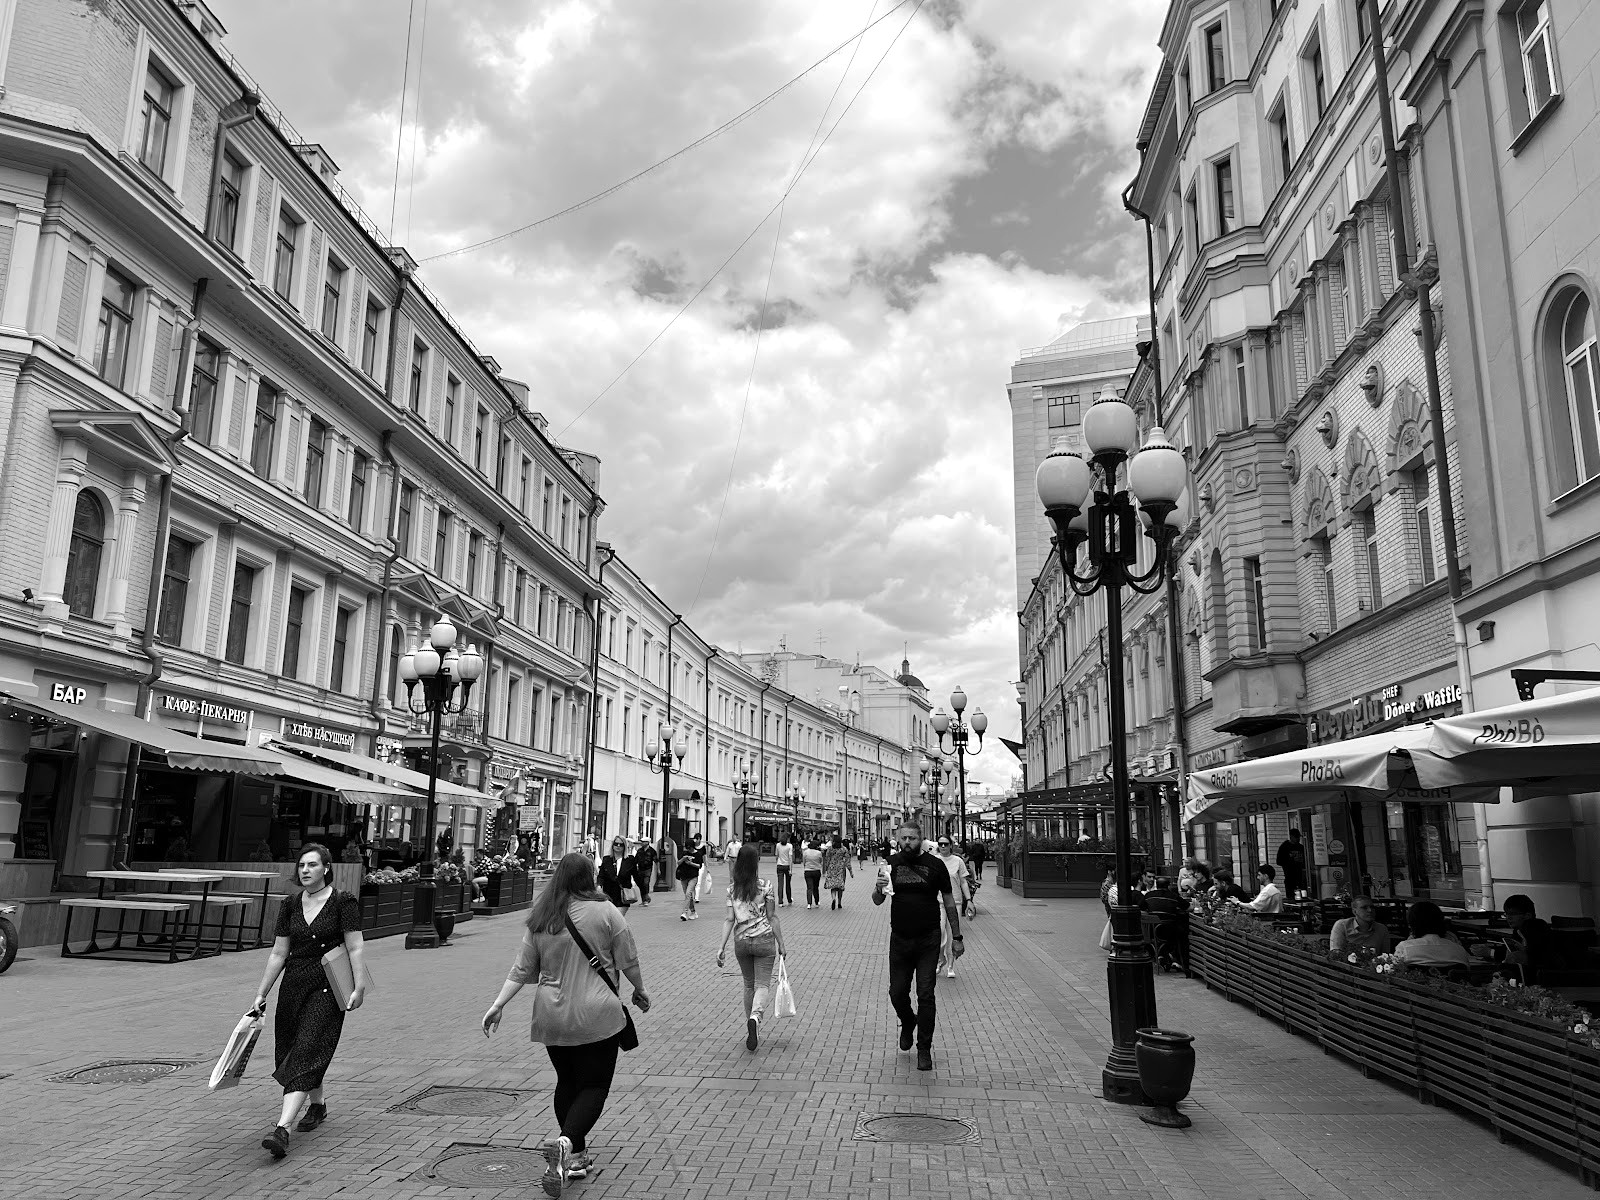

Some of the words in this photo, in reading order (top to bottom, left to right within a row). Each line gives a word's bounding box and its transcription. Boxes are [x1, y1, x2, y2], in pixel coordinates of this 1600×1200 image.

[53, 683, 87, 704] БАР
[1382, 685, 1399, 700] SHEF
[1384, 701, 1416, 721] Döner
[1423, 685, 1462, 709] Waffle
